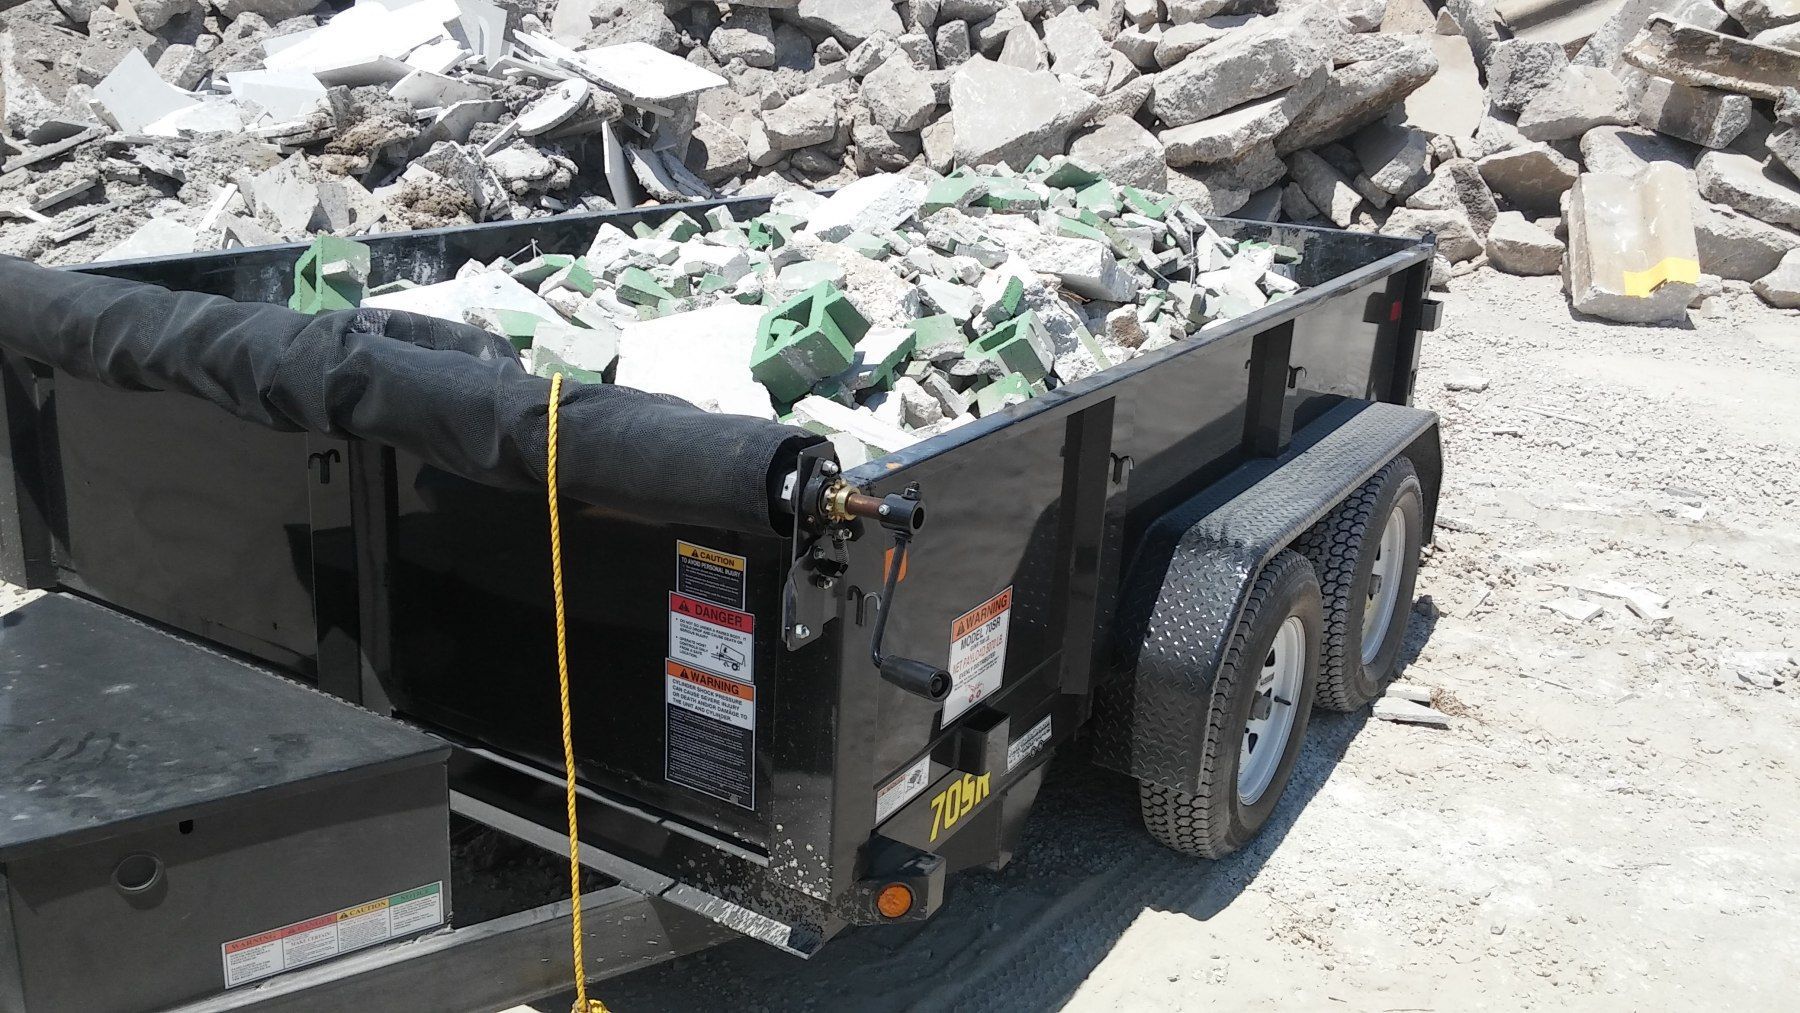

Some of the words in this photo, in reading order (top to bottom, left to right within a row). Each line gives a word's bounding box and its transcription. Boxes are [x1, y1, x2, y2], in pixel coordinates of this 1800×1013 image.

[700, 551, 734, 566] CAUTION
[701, 562, 724, 574] PERSONAL
[725, 568, 740, 578] INJURY
[695, 605, 742, 627] DANGER
[966, 595, 1007, 628] WARNING
[961, 628, 983, 650] MODEL
[673, 679, 696, 690] CYLINDER
[697, 685, 714, 697] SHOCK
[715, 692, 742, 705] PRESSURE
[691, 671, 739, 695] WARNING
[681, 694, 696, 703] DEATH
[717, 706, 739, 718] DAMAGE
[684, 688, 700, 698] CAUSE
[701, 693, 722, 705] SEVERE
[721, 701, 739, 711] INJURY
[349, 901, 387, 916] CAUTION
